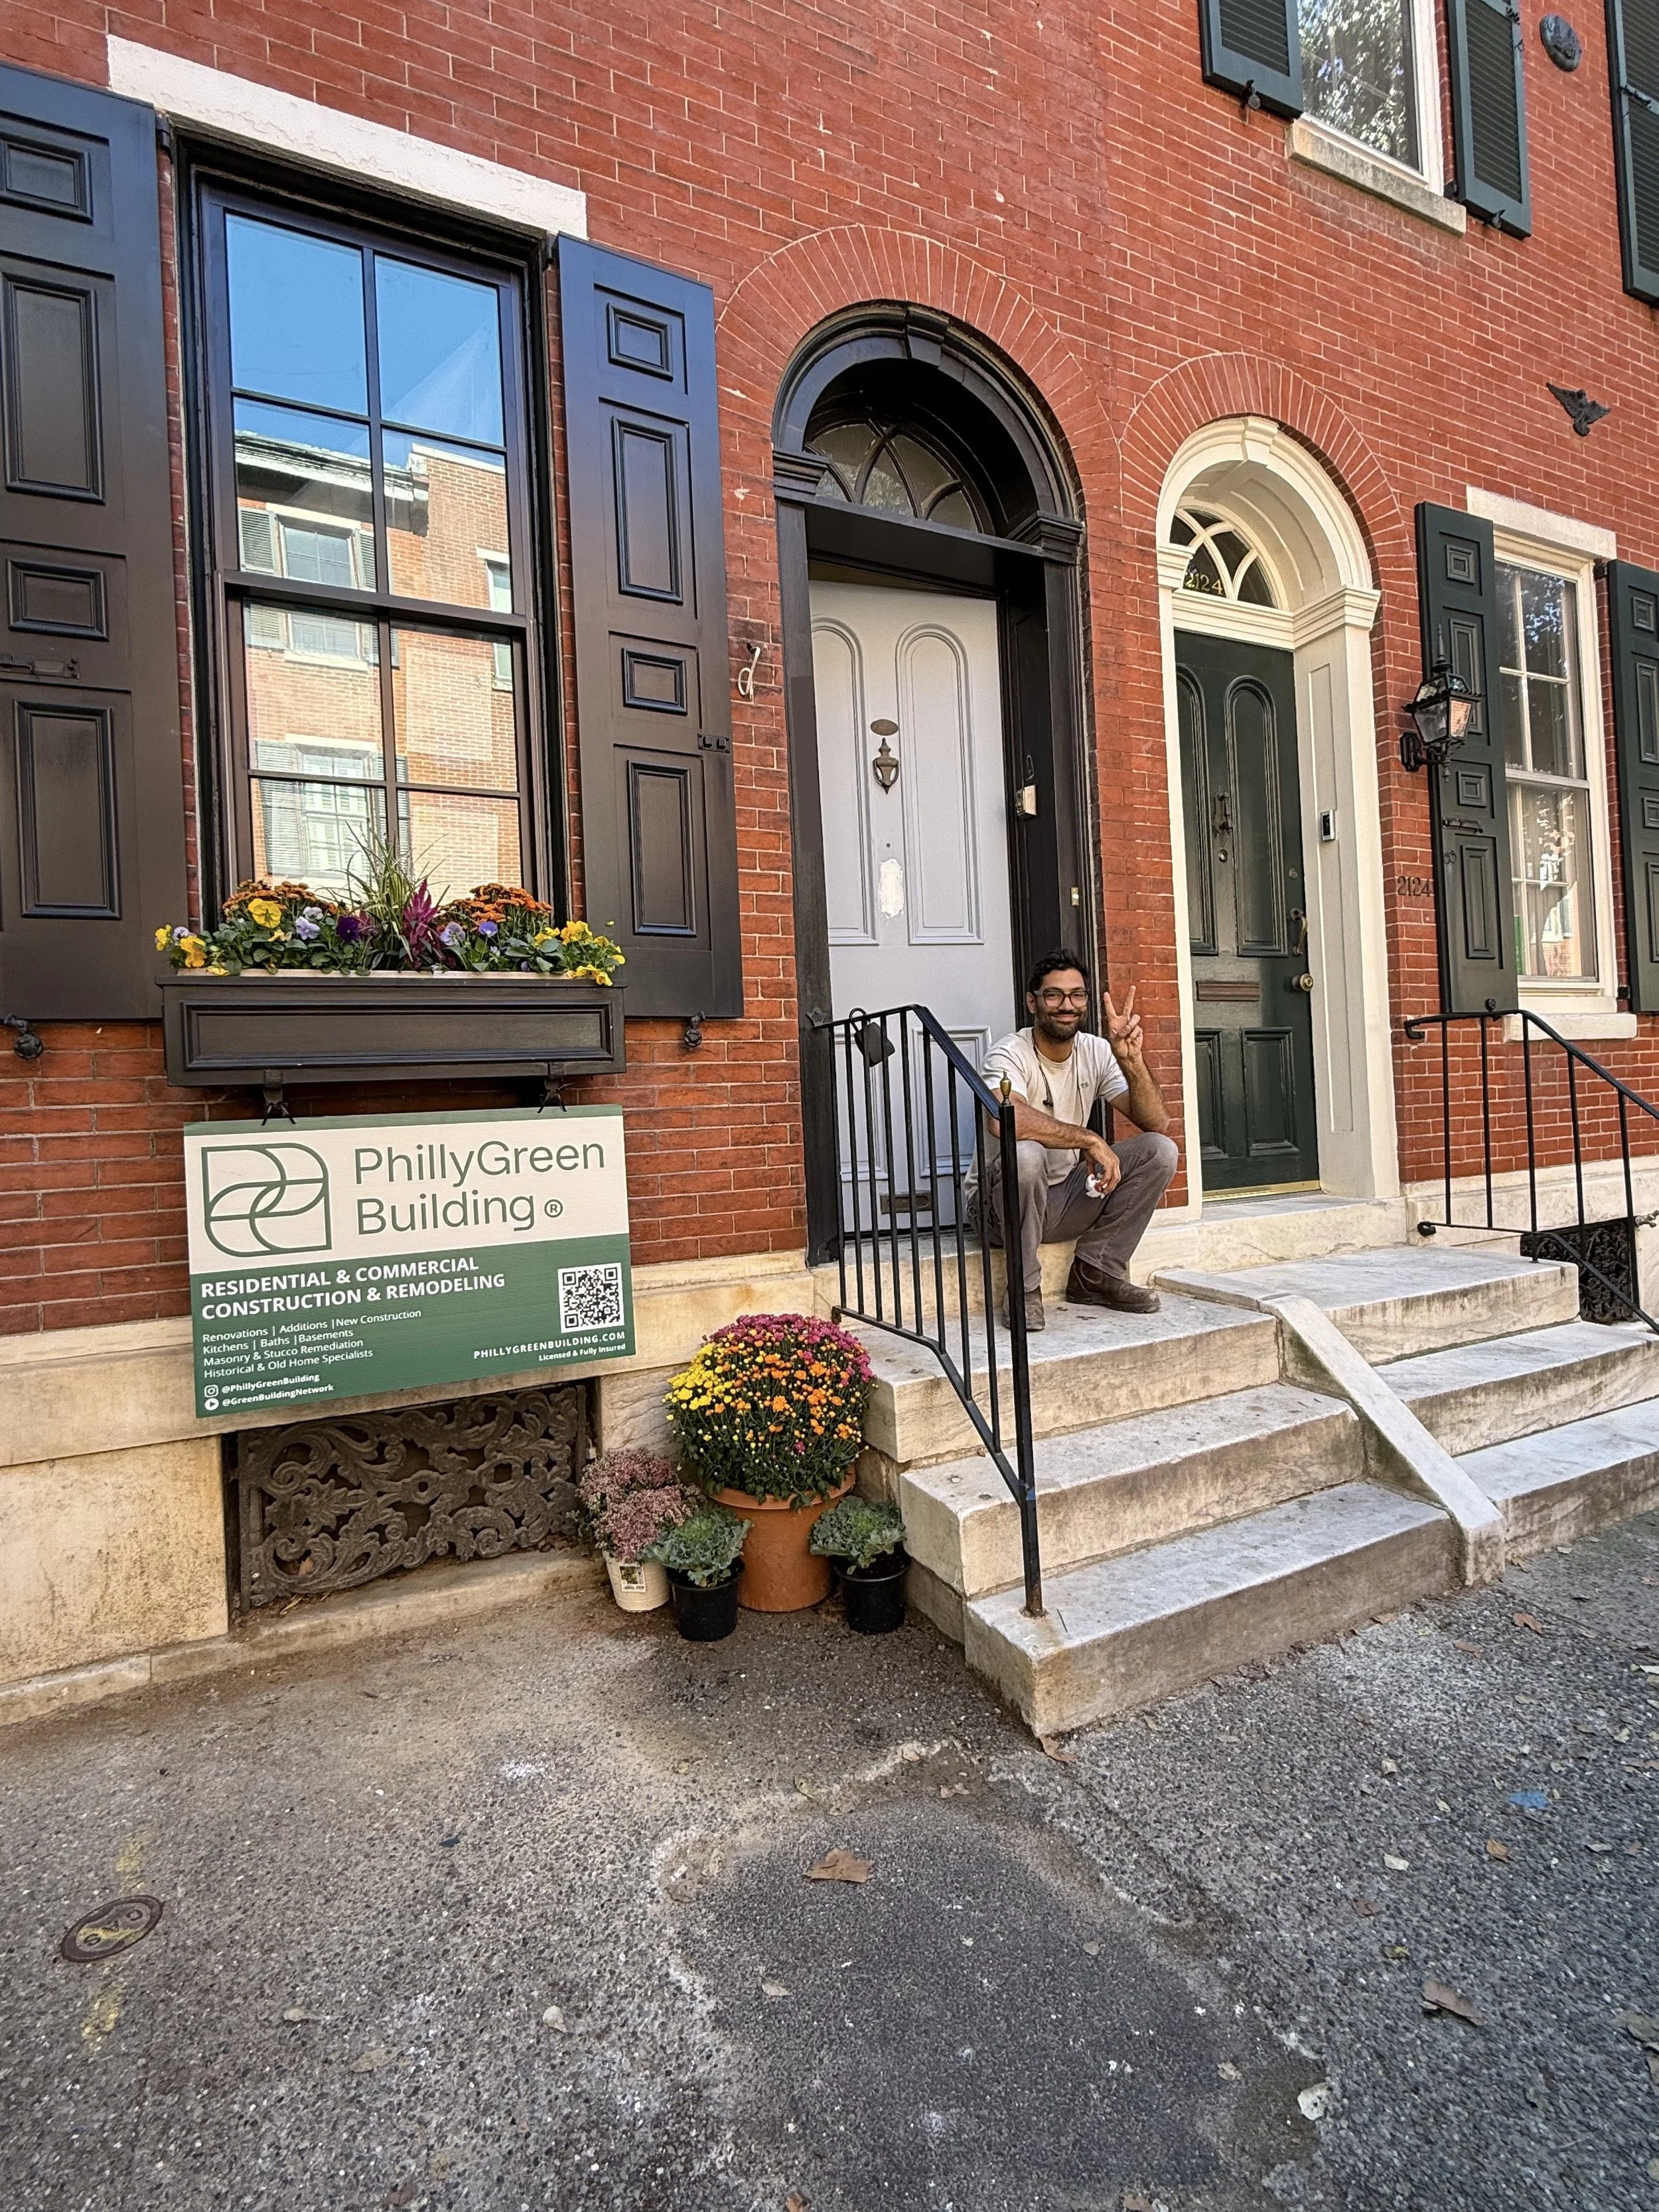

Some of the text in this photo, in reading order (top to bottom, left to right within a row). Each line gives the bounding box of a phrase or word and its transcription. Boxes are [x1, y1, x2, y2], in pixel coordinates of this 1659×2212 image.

[1398, 876, 1431, 897] 2124
[354, 1140, 605, 1187] PhillyGreen
[356, 1189, 535, 1235] Building
[201, 1257, 479, 1298] RESIDENTIAL & COMMERCIAL
[202, 1274, 505, 1320] CONSTRUCTION & REMODELING
[202, 1328, 269, 1343] Renovations
[279, 1321, 328, 1334] Additions
[360, 1310, 421, 1324] Construction
[203, 1342, 249, 1355] Kitchens
[260, 1337, 290, 1348] Baths
[203, 1339, 364, 1366] Masonry & Stucco Remediation
[474, 1331, 625, 1359] PHILLYGREENBUILDING.COM
[539, 1350, 571, 1361] Licensed
[579, 1347, 597, 1356] Fully
[599, 1343, 626, 1353] Insured
[204, 1349, 374, 1378] Historical & Old Home Specialists
[222, 1373, 321, 1394] @PhillyGreenBuilding
[222, 1384, 334, 1406] @GreenBuildingNetwork
[84, 1909, 143, 1946] GAS
